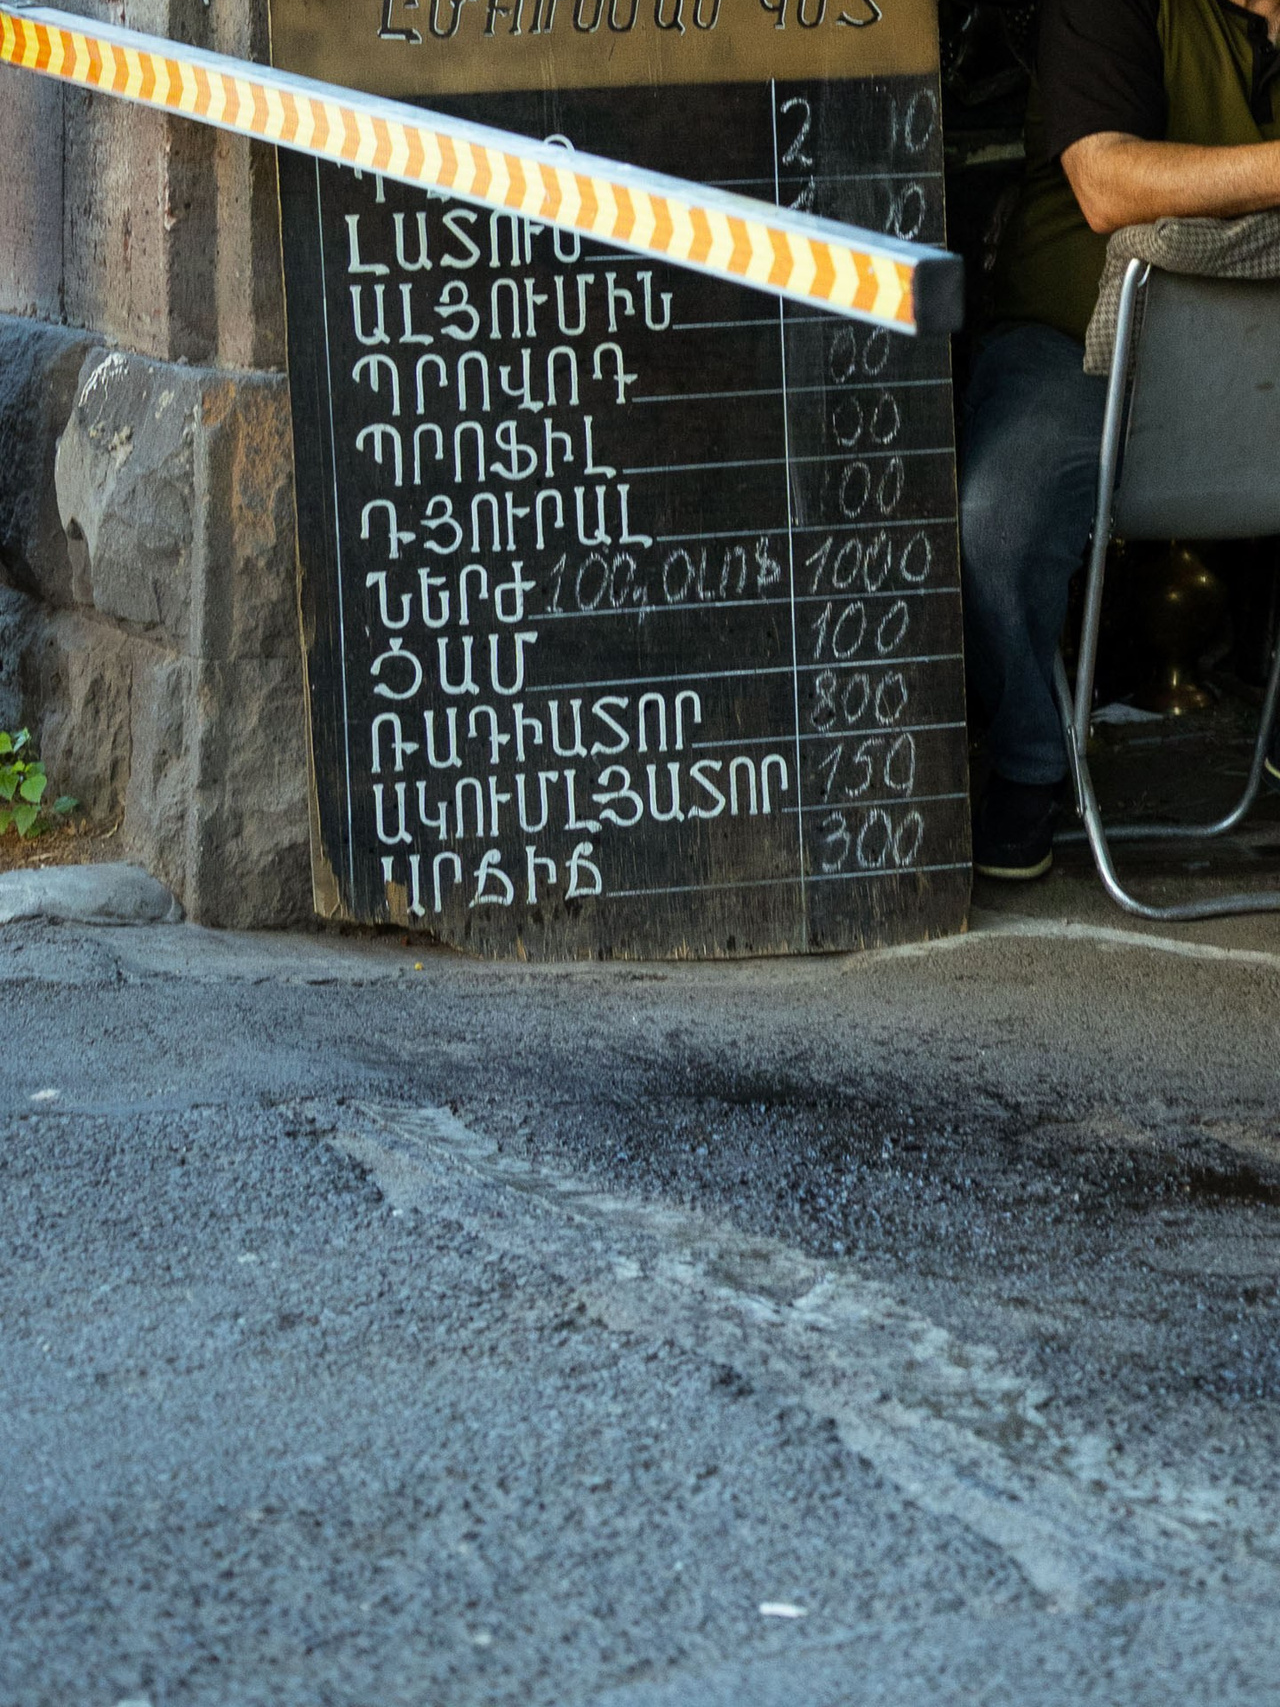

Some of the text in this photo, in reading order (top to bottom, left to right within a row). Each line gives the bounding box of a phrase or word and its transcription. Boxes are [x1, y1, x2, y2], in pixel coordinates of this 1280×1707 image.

[350, 271, 673, 345] ԱԼՅՈՒՄԻՆ
[352, 342, 637, 416] ՊՐՈՎՈԴ
[356, 415, 617, 486] ՊՐՈՖԻԼ
[360, 484, 653, 560] ԴՅՈՒՐԱԼ
[366, 560, 537, 629] ՆԵՐԺ
[812, 600, 910, 659] 100
[372, 669, 909, 774] ՌԱԴԻԱՏՈՐ 800
[373, 732, 917, 845] ԱԿՈՒՄԼՅԱՏՈՐ 150
[380, 808, 925, 918] ԱՐՃԻՃ 300
